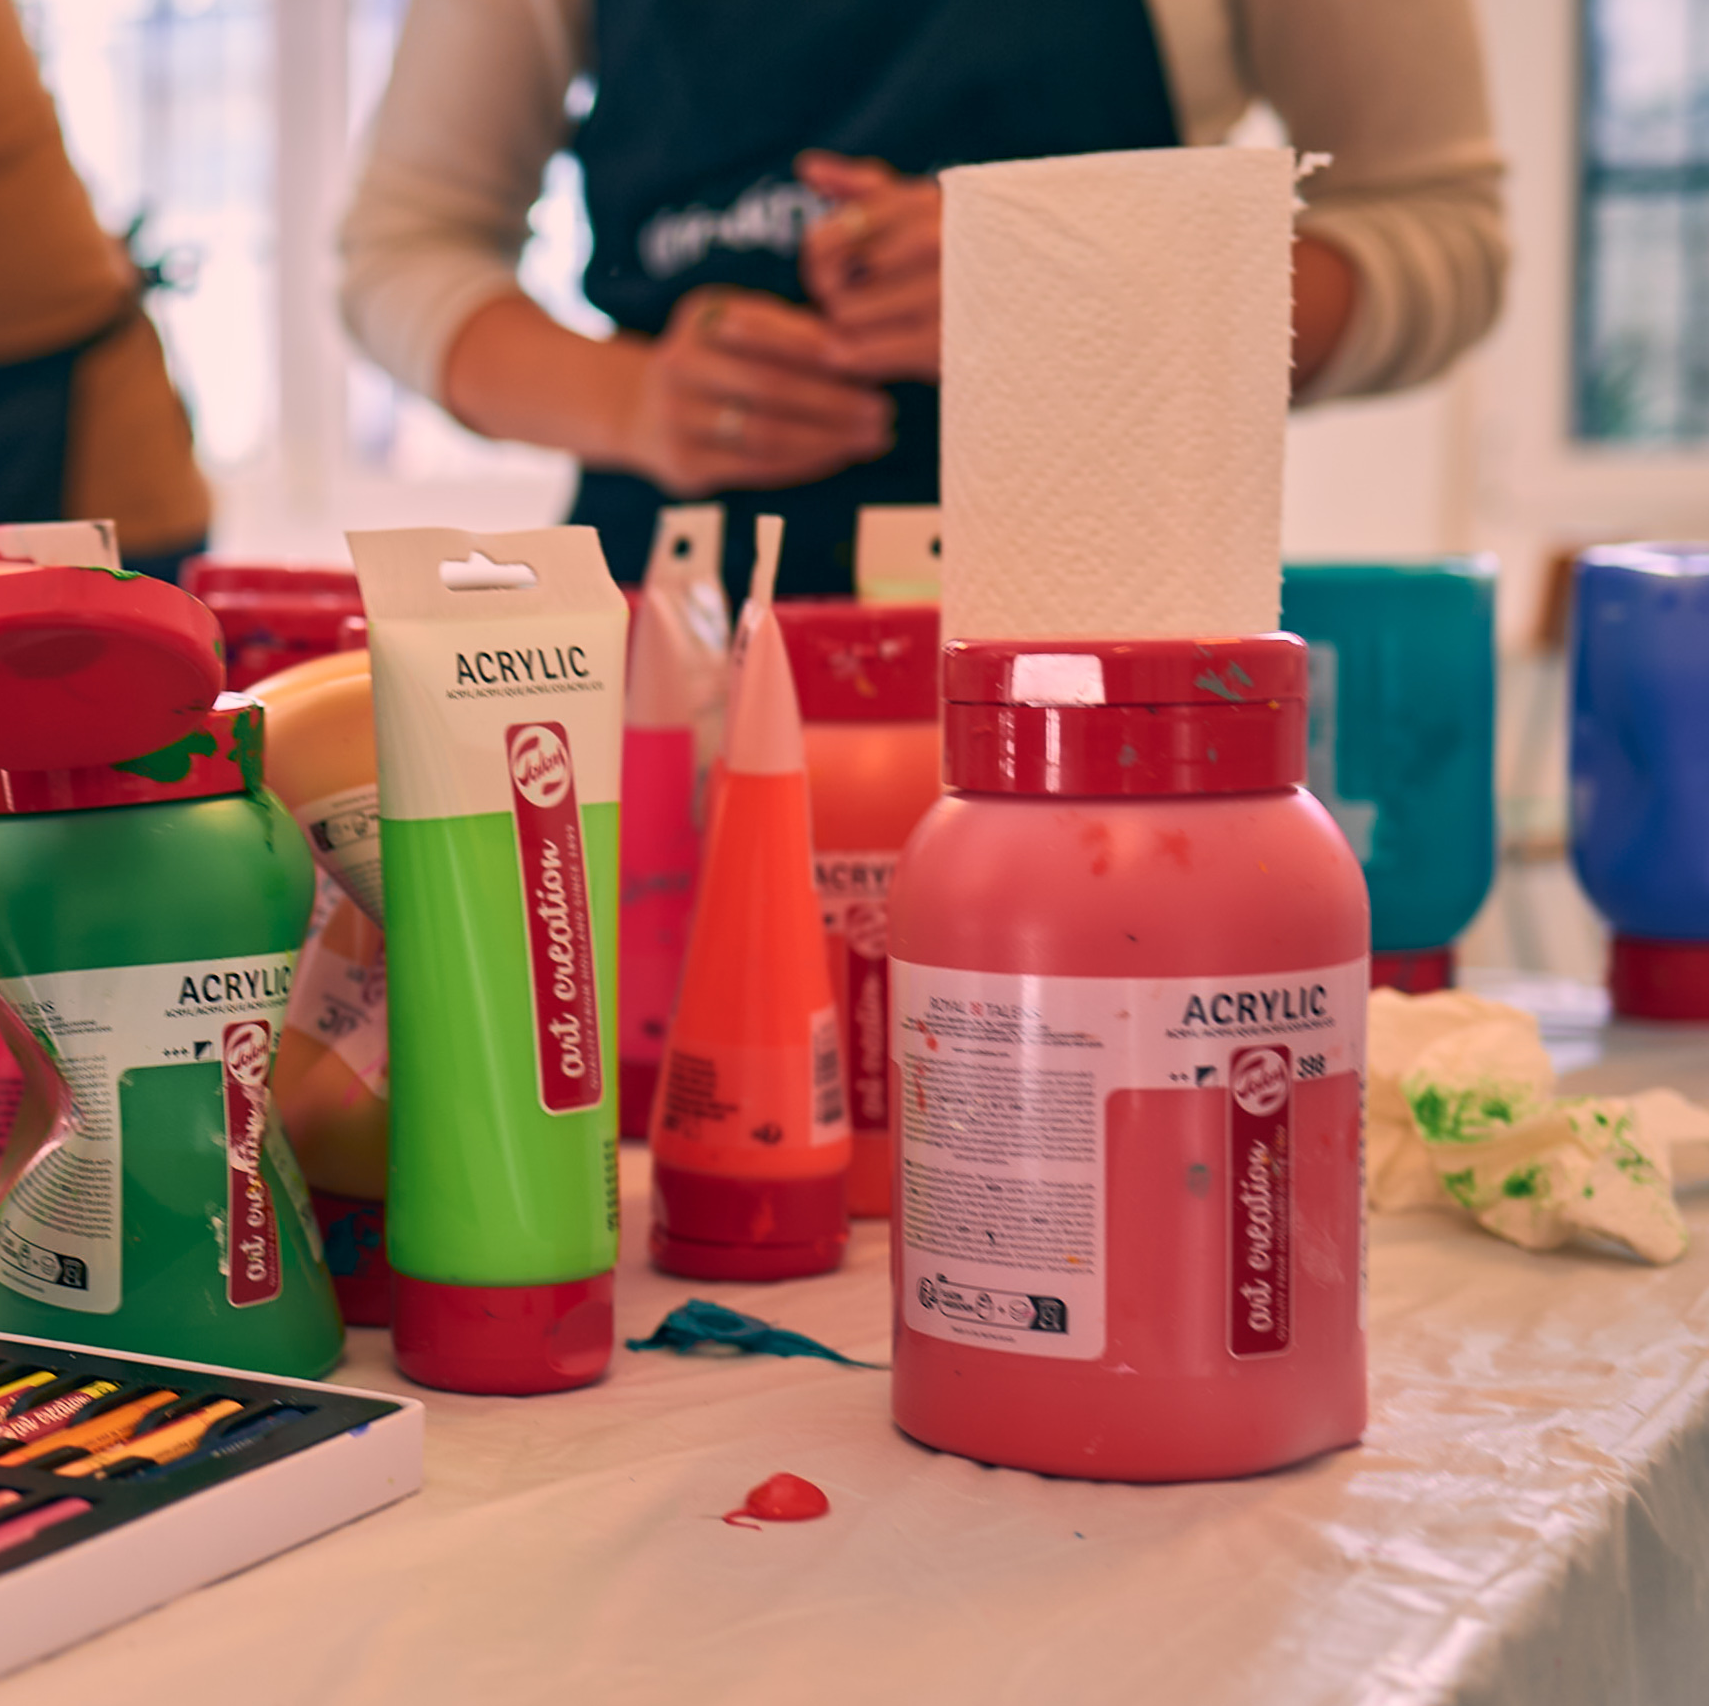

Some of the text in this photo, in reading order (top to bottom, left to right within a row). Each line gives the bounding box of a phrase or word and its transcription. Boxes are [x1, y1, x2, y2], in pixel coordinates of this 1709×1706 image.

[456, 646, 590, 685] ACRYLIC
[815, 859, 890, 889] ACRY
[536, 839, 585, 1078] art creation
[178, 965, 291, 1005] ACRYLIC
[1181, 983, 1327, 1026] ACRYLIC
[1239, 1138, 1274, 1333] art creation
[239, 1235, 267, 1281] art
